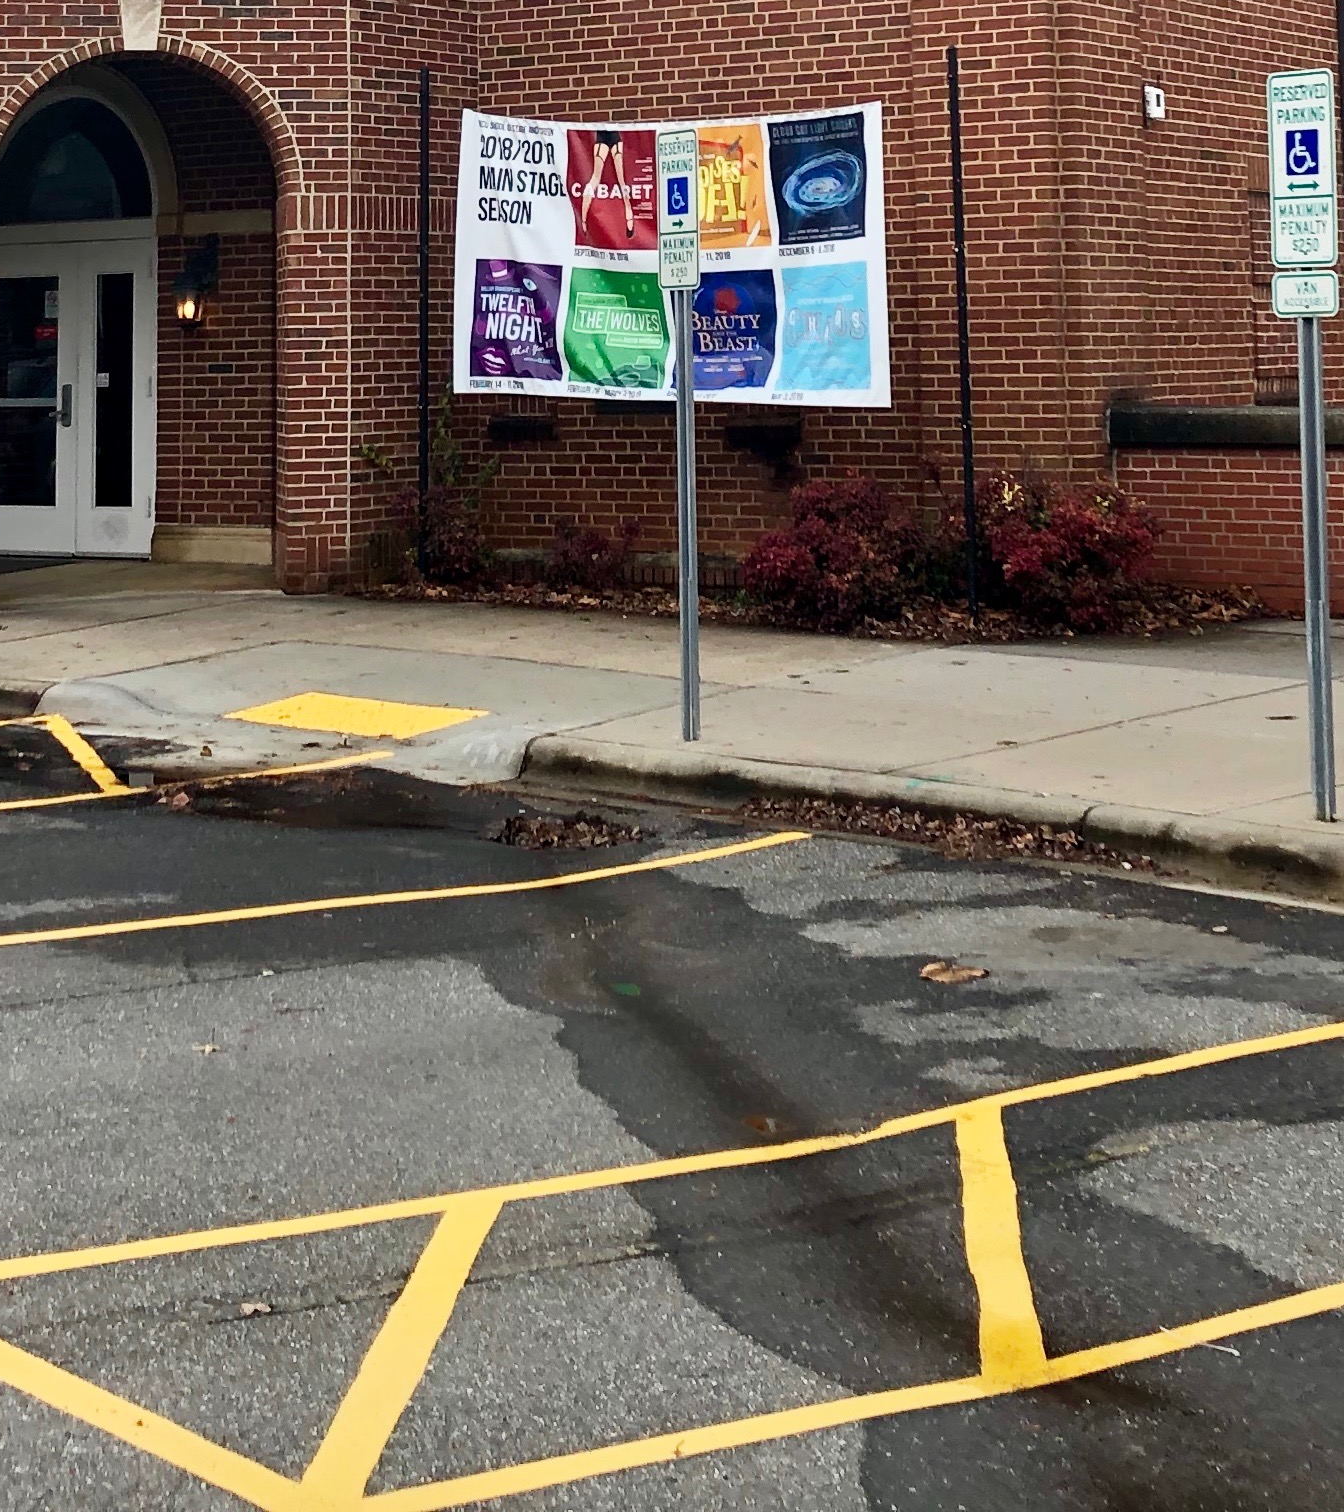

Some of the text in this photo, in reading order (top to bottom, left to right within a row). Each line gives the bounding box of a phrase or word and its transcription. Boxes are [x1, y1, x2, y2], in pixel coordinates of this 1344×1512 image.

[1272, 82, 1327, 102] RESERVED
[1276, 105, 1326, 125] PARKING
[659, 139, 695, 157] RESERVED
[661, 158, 694, 175] PARKING
[698, 155, 742, 188] OISES
[571, 182, 654, 200] CABARET
[1278, 202, 1329, 218] MAXIMUM
[1280, 219, 1328, 236] PENALTY
[662, 236, 695, 252] MAXIMUM
[1292, 237, 1319, 254] $250
[664, 251, 694, 266] PENALTY
[480, 293, 536, 315] TWELFTH
[484, 312, 544, 344] NIGHT
[579, 309, 660, 332] THE WOLVES
[692, 310, 761, 331] BEAUTY
[698, 331, 757, 353] BEAST
